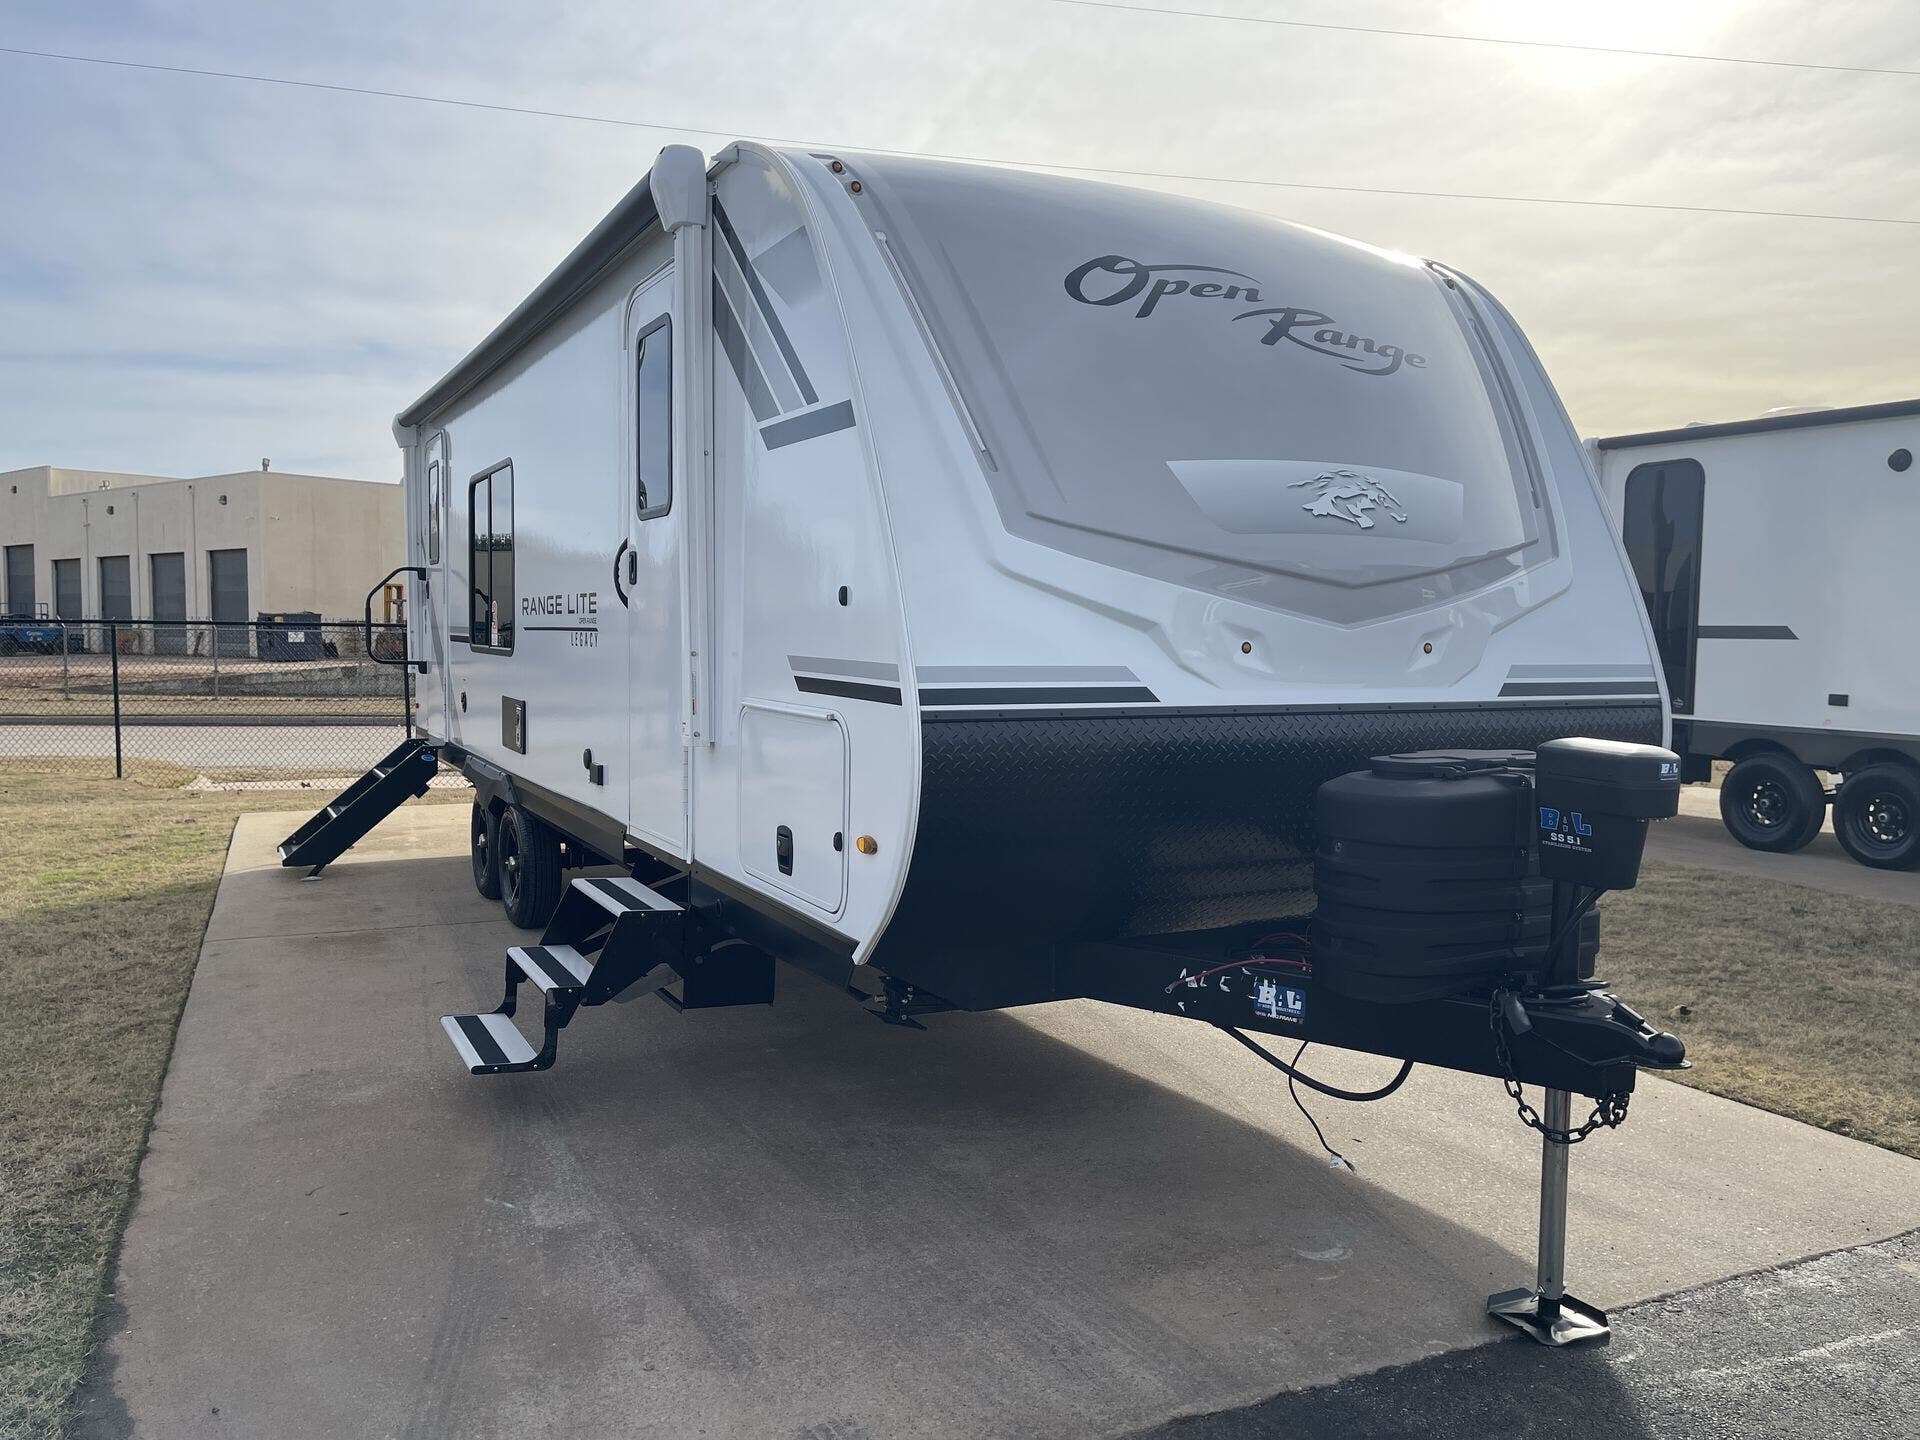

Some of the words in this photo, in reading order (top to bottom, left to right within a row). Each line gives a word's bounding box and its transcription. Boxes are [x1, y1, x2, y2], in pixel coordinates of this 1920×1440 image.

[1064, 255, 1264, 318] Open
[1232, 307, 1428, 376] Range
[522, 595, 563, 616] RANGE
[567, 592, 597, 614] LITE
[571, 632, 598, 648] LEGACY
[1661, 763, 1679, 774] BAL
[1540, 807, 1592, 836] BAL
[1257, 985, 1302, 1010] BAL
